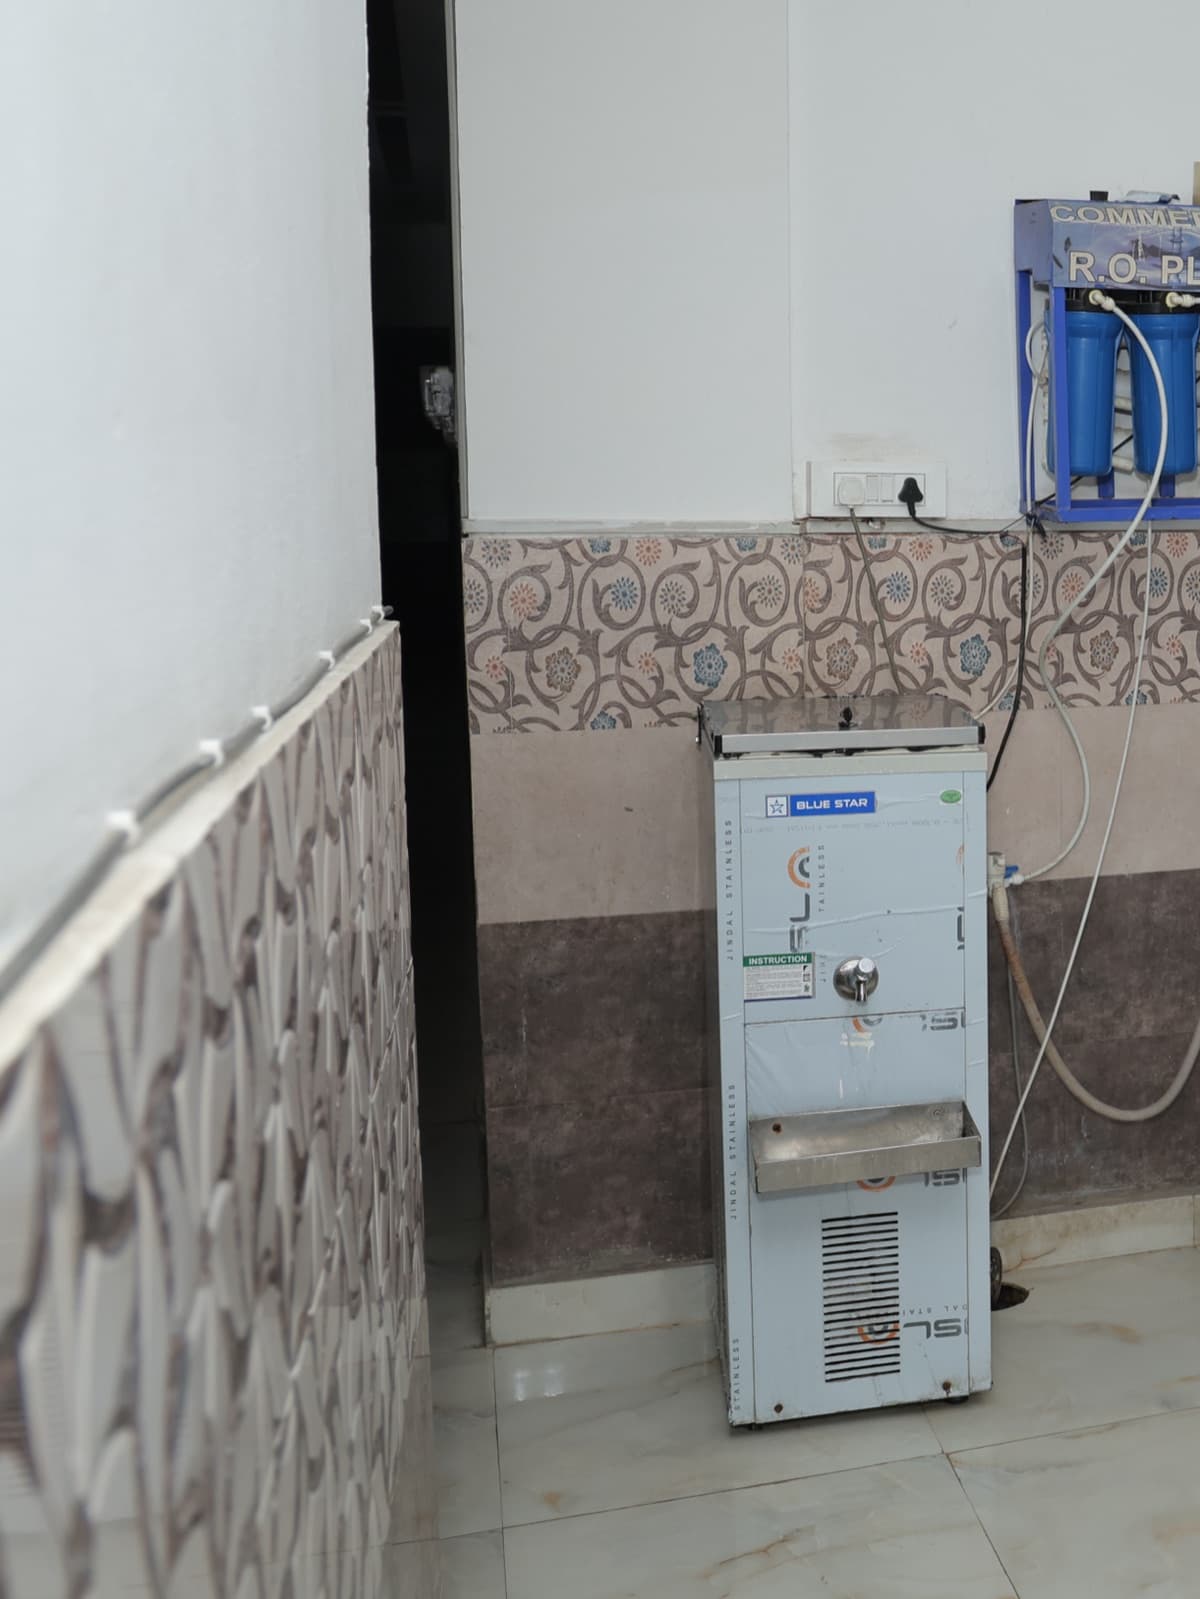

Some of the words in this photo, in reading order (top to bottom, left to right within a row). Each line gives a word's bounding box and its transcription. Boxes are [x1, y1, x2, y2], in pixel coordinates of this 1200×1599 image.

[1069, 251, 1146, 284] R.O.
[796, 800, 831, 810] BLUE
[834, 798, 868, 809] STAR
[725, 820, 733, 899] STAINLESS
[726, 911, 734, 960] JINDAL
[749, 955, 808, 965] INSTRUCTION
[728, 1085, 736, 1160] STAINLESS
[729, 1171, 737, 1220] JINDAL
